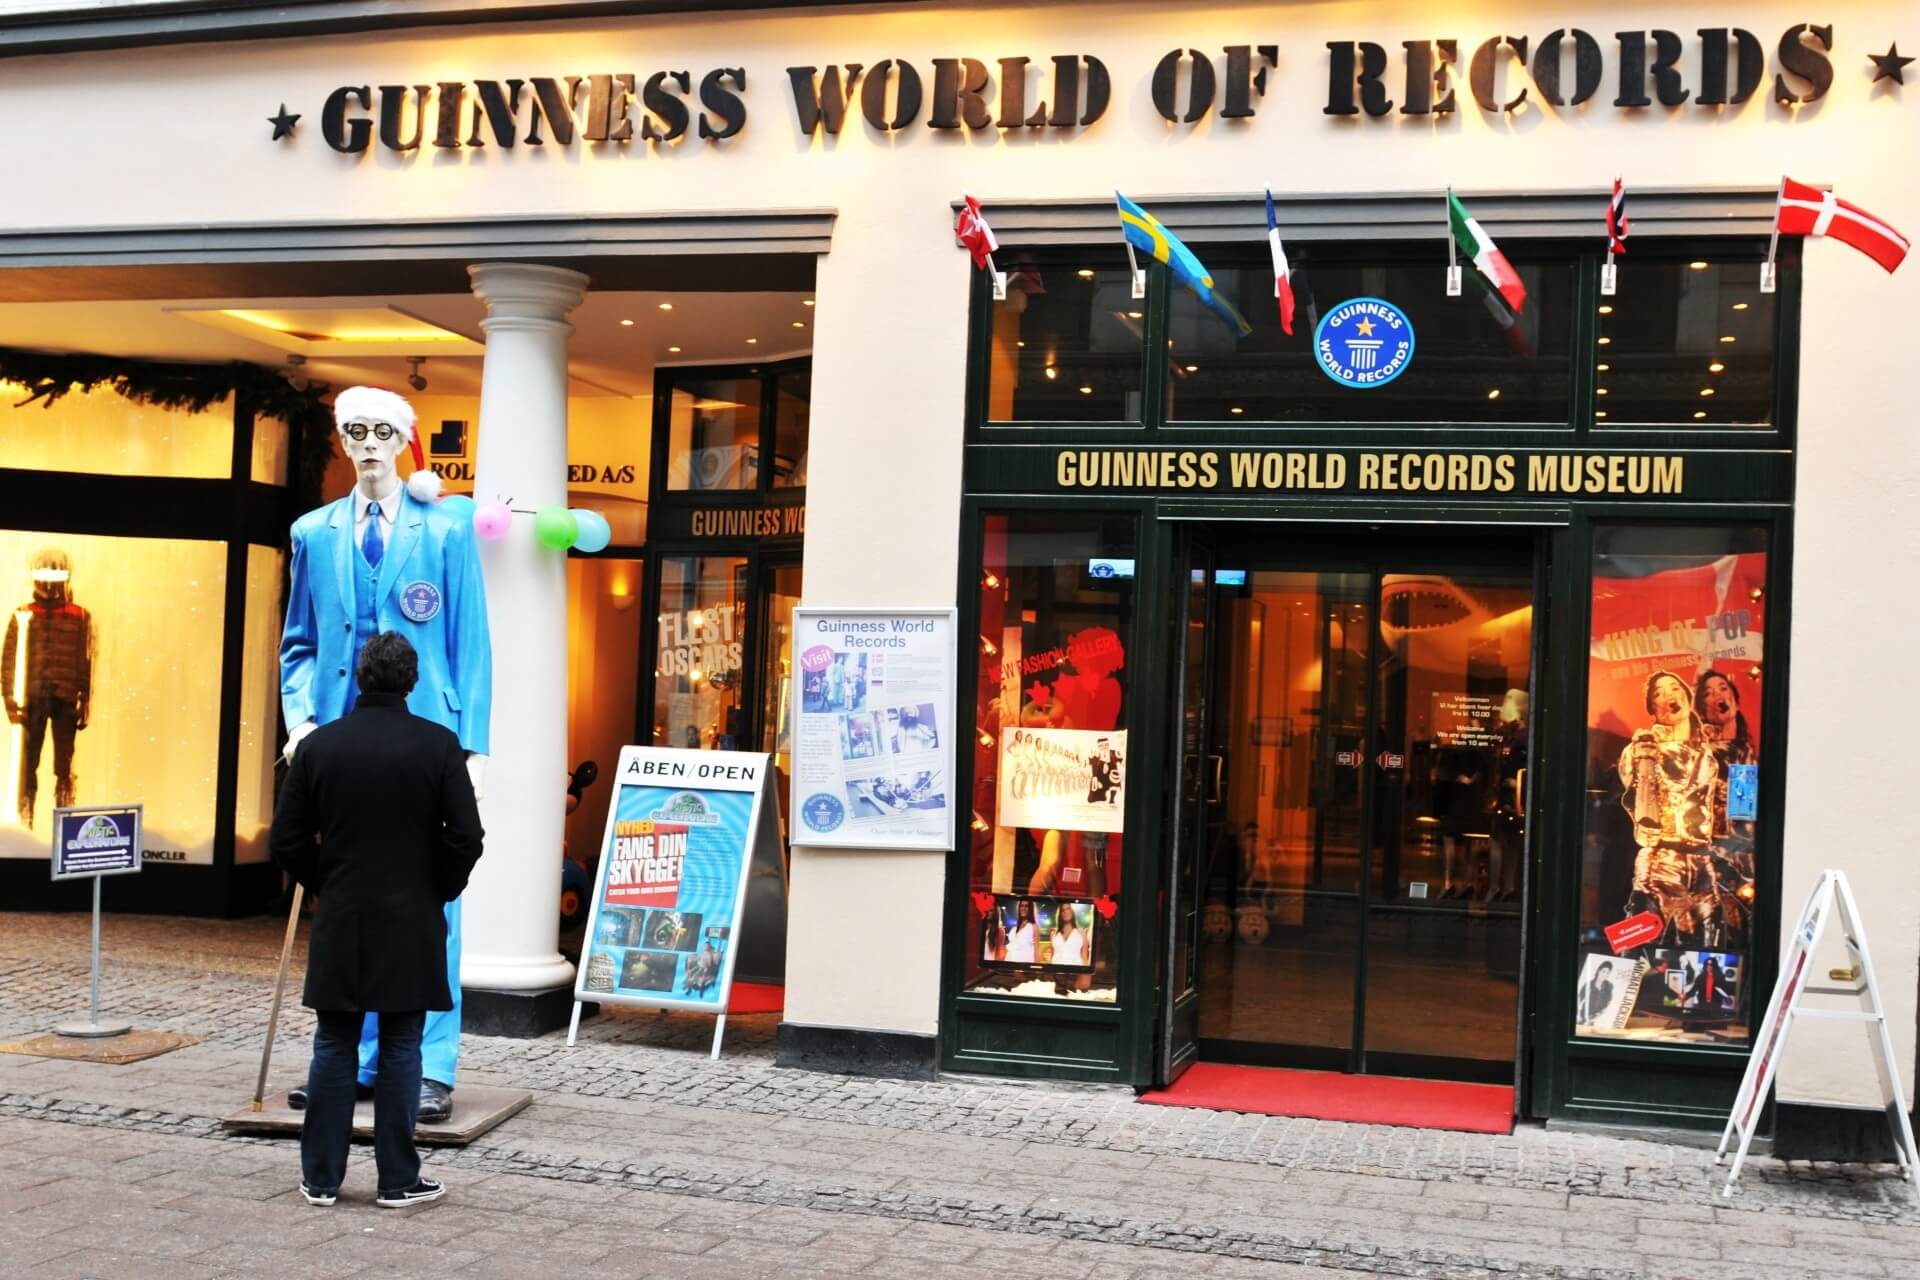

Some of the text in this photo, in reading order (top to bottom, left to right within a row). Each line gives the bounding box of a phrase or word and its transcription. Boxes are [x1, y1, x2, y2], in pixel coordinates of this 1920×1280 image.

[322, 23, 1833, 153] GUINNESS WORLD OF RECORDS
[1330, 303, 1402, 329] GUINNESS
[1320, 339, 1409, 382] WORLD RECORDS
[601, 465, 635, 483] A/S
[1056, 450, 1684, 495] GUINNESS WORLD RECORDS MUSEUM
[692, 508, 780, 536] GUINNESS
[660, 607, 735, 649] FLEST
[817, 619, 934, 633] Guinness World
[1604, 609, 1753, 660] KING OF POP
[844, 635, 906, 648] Records
[662, 642, 743, 676] OSCARS
[801, 648, 832, 669] Visit
[1017, 646, 1065, 676] FASHION
[615, 819, 656, 836] NYHED
[613, 835, 656, 861] FANG
[657, 832, 688, 858] DIN
[609, 856, 684, 885] SKYGGE!
